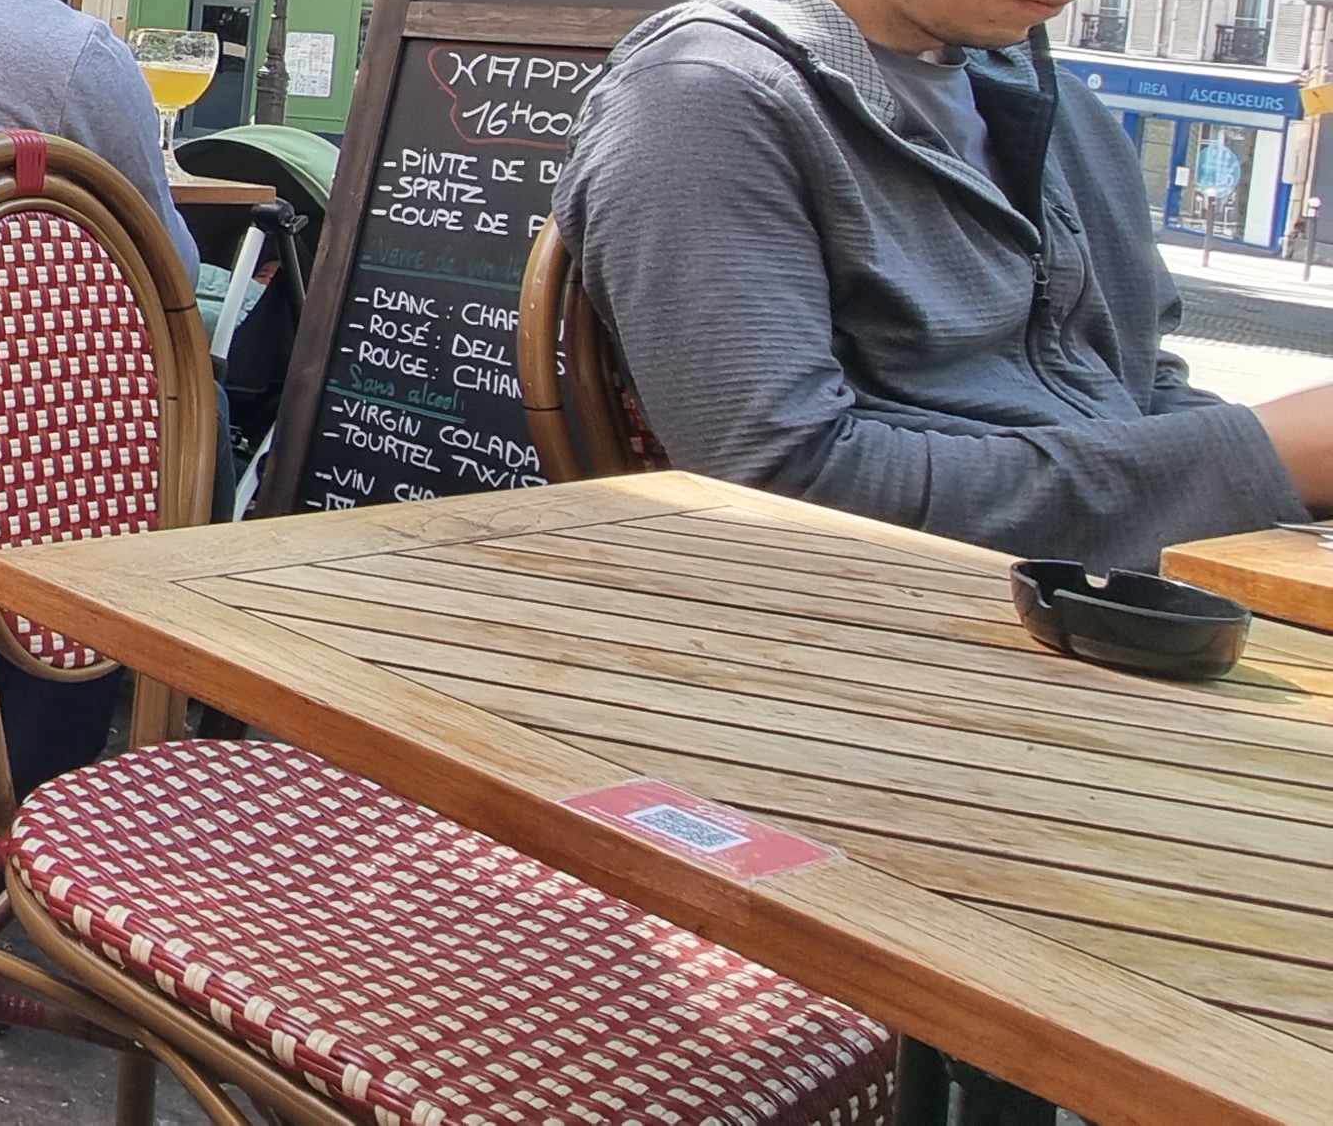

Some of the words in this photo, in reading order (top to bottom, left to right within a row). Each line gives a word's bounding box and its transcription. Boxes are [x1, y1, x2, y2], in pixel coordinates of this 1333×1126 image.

[449, 52, 603, 94] HAPPY
[1138, 82, 1168, 97] IREA
[1190, 88, 1284, 111] ASCENSEURS
[492, 158, 525, 182] DE
[474, 212, 509, 235] DE
[438, 425, 541, 472] COLADA
